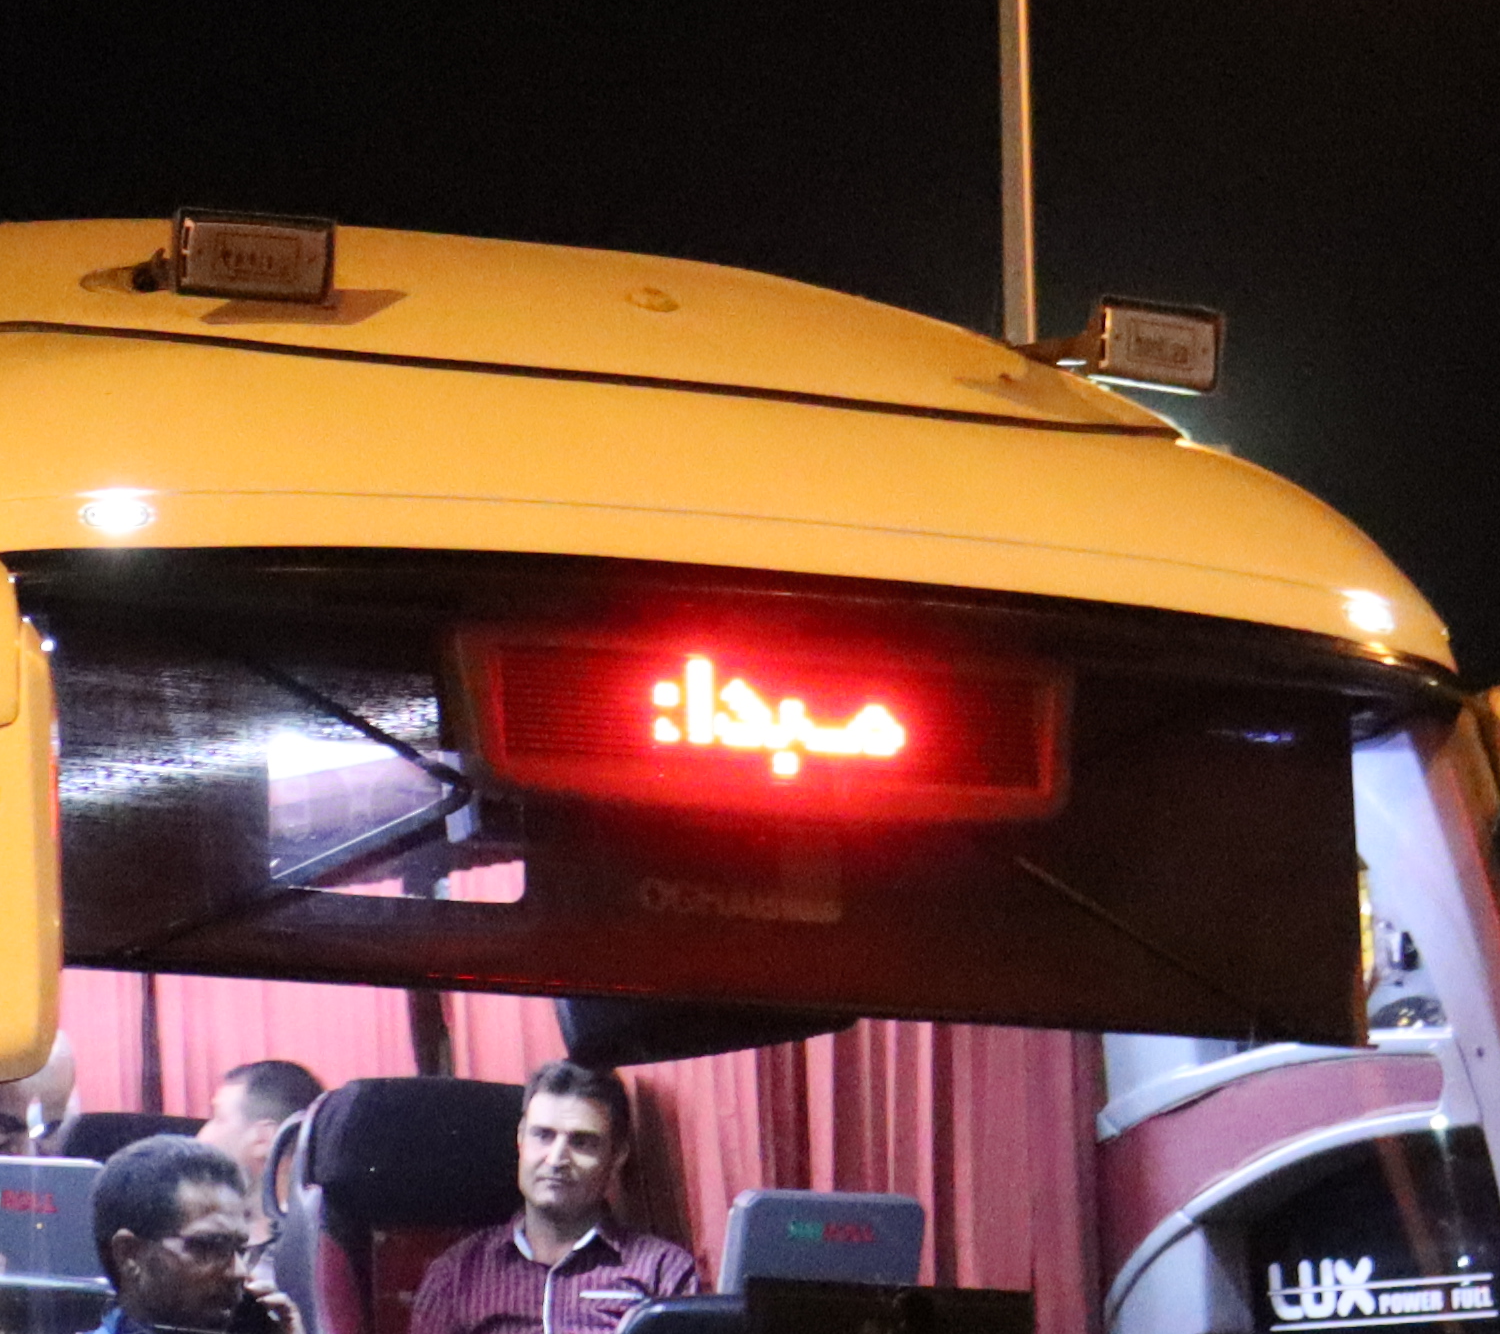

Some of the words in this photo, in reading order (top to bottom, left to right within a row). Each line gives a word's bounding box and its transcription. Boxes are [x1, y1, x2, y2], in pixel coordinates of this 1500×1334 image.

[1268, 1255, 1375, 1321] LUX
[1378, 1289, 1444, 1315] POWER
[1450, 1285, 1494, 1310] FULL
